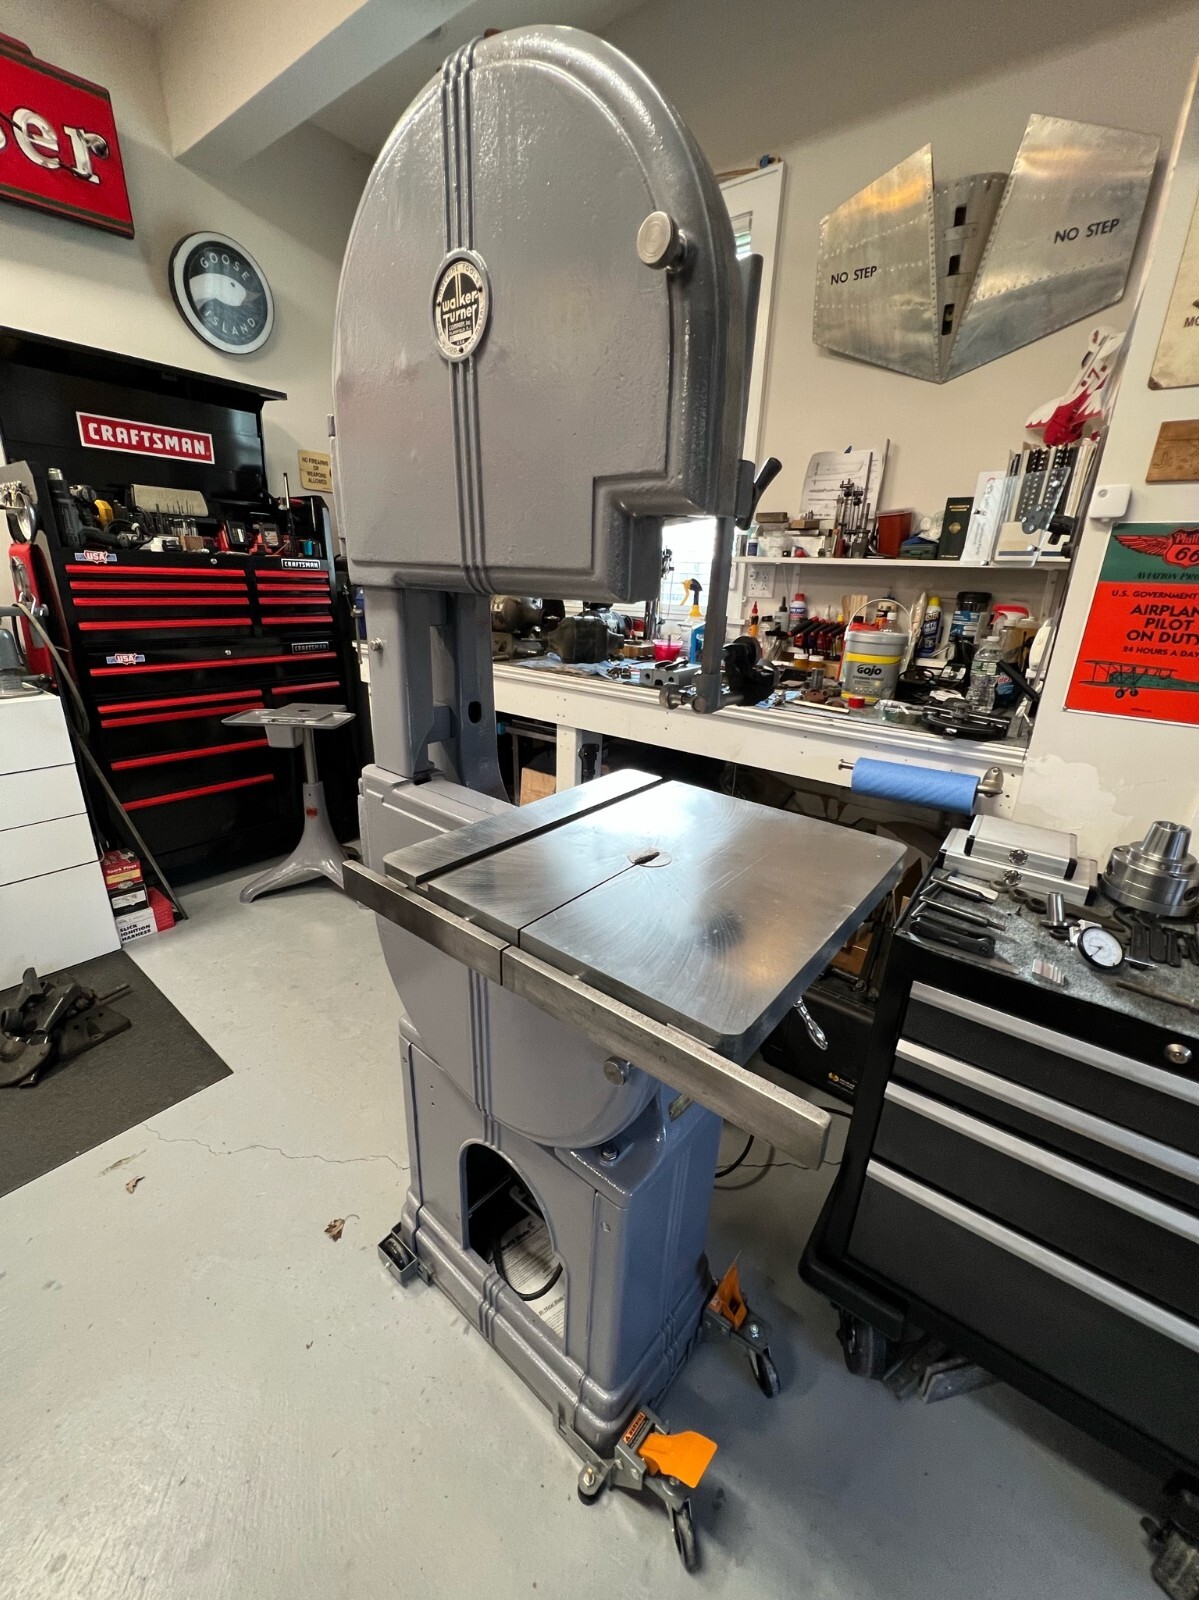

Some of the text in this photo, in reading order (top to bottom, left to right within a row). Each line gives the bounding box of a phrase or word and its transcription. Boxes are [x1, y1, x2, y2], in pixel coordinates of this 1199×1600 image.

[0, 107, 109, 184] er
[1054, 219, 1120, 244] NO STEP
[200, 253, 250, 281] GOOSE
[831, 265, 877, 285] NO STEP
[205, 310, 256, 336] ISLAND
[87, 422, 206, 455] CRAFTSMAN
[86, 552, 106, 561] USA
[284, 561, 319, 569] CRAFTSMAN
[1111, 589, 1199, 600] U.S. GOVERNMENT
[1130, 604, 1199, 618] AIRPLAN
[1144, 617, 1195, 631] PILOT
[1126, 629, 1199, 646] ON DUTY
[1136, 647, 1168, 656] HOURS
[1180, 651, 1199, 659] DAY
[120, 923, 138, 932] SLICK
[120, 924, 150, 937] IGNITION
[122, 930, 151, 941] HARNESS
